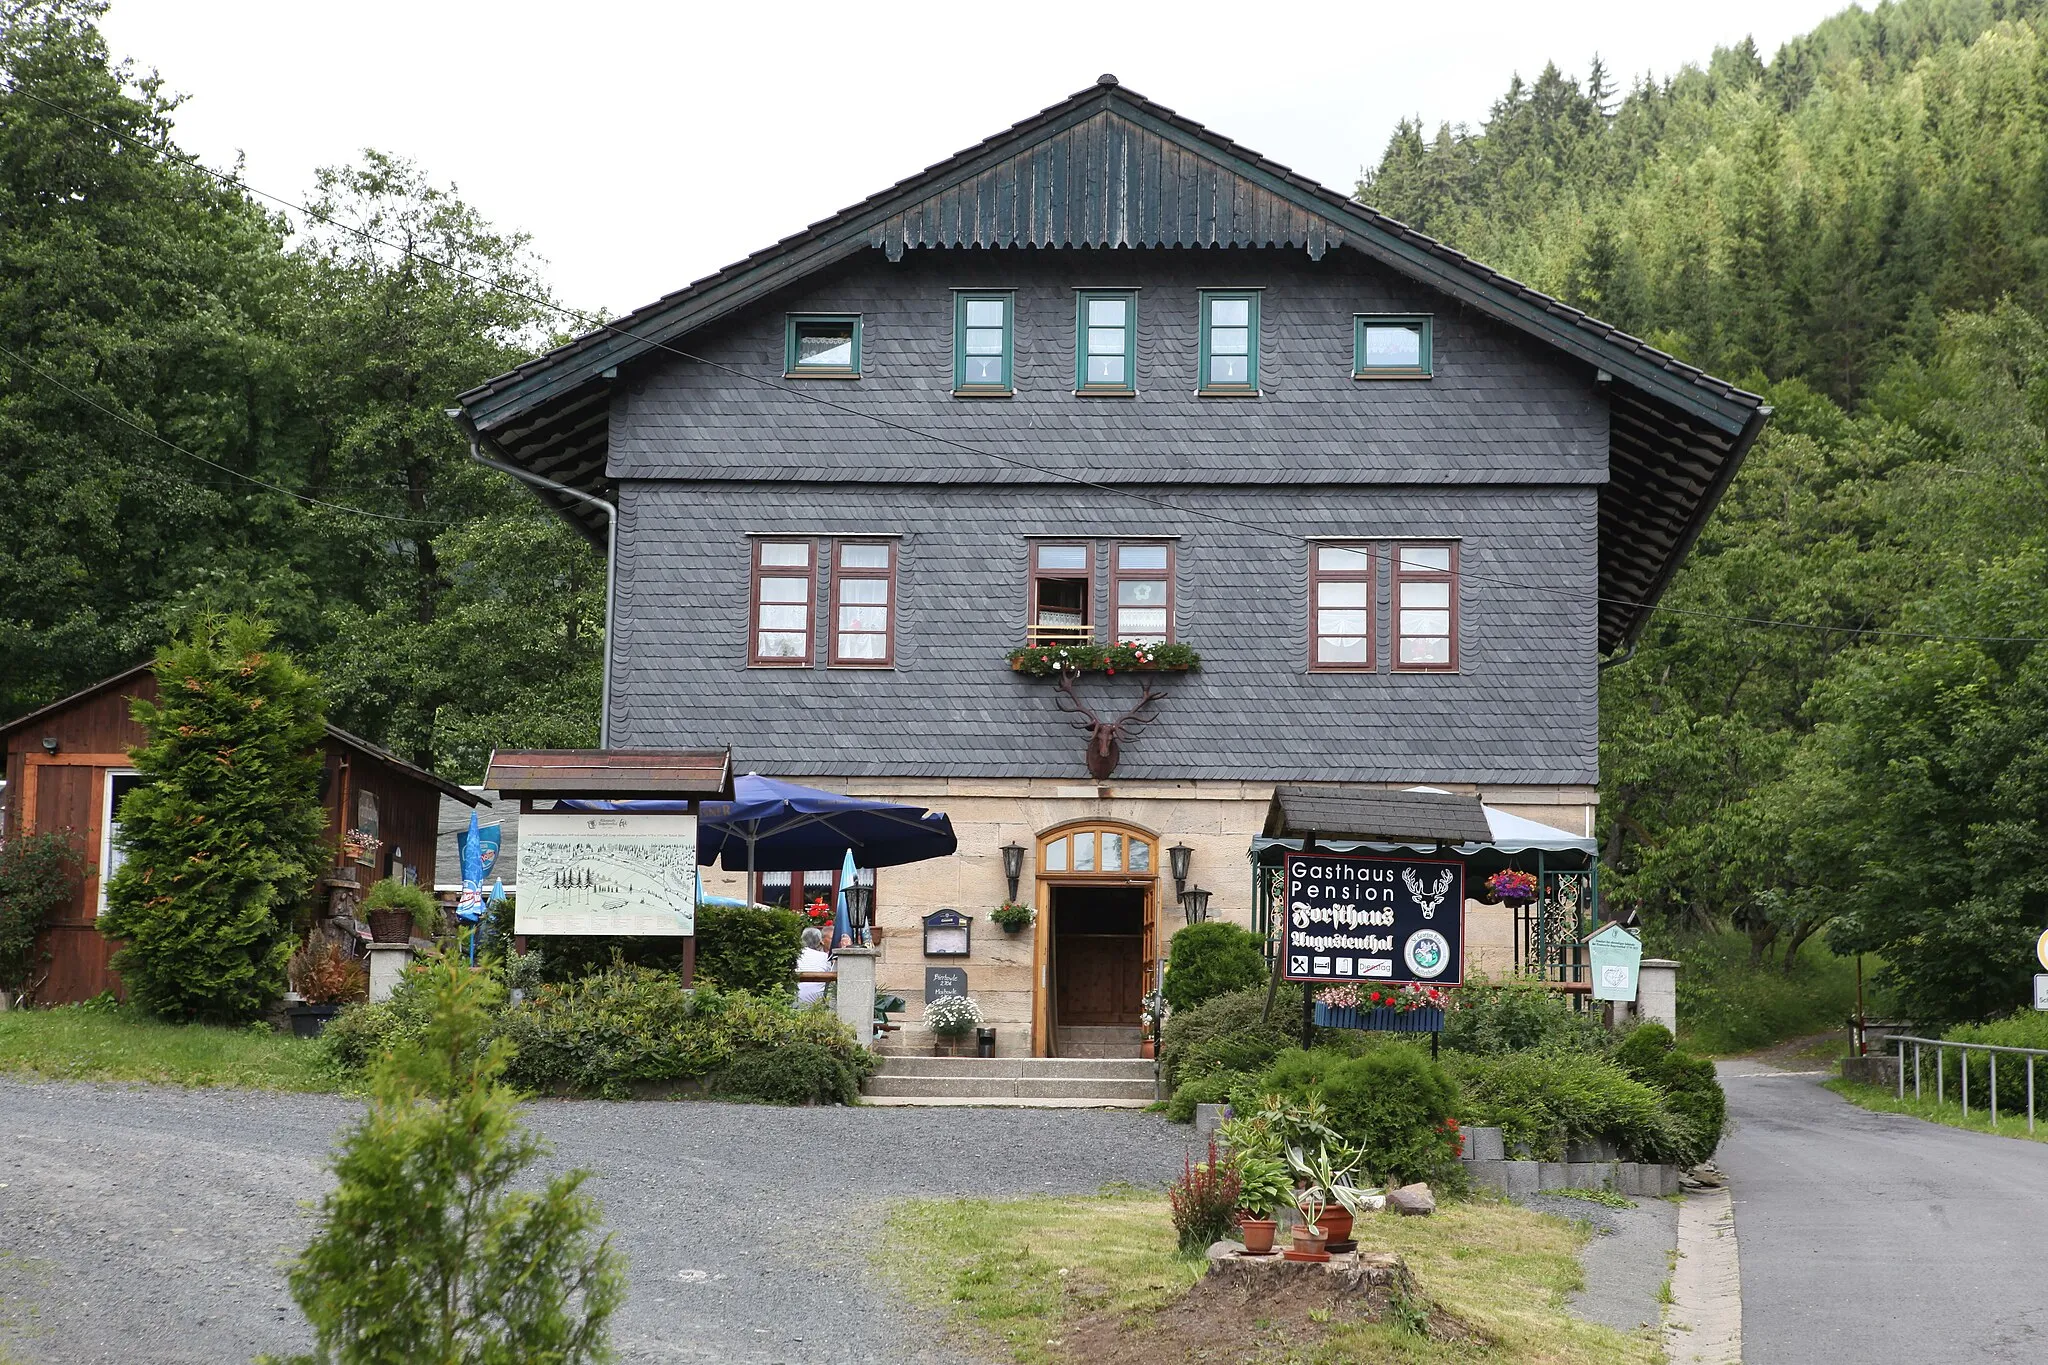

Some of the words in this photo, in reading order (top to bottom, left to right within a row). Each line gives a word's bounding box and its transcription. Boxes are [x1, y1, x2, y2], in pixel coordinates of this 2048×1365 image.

[1292, 862, 1394, 882] Gasthaus
[1291, 881, 1394, 902] Pension
[1290, 931, 1394, 955] Augustenthal
[1359, 962, 1391, 972] Dienstag
